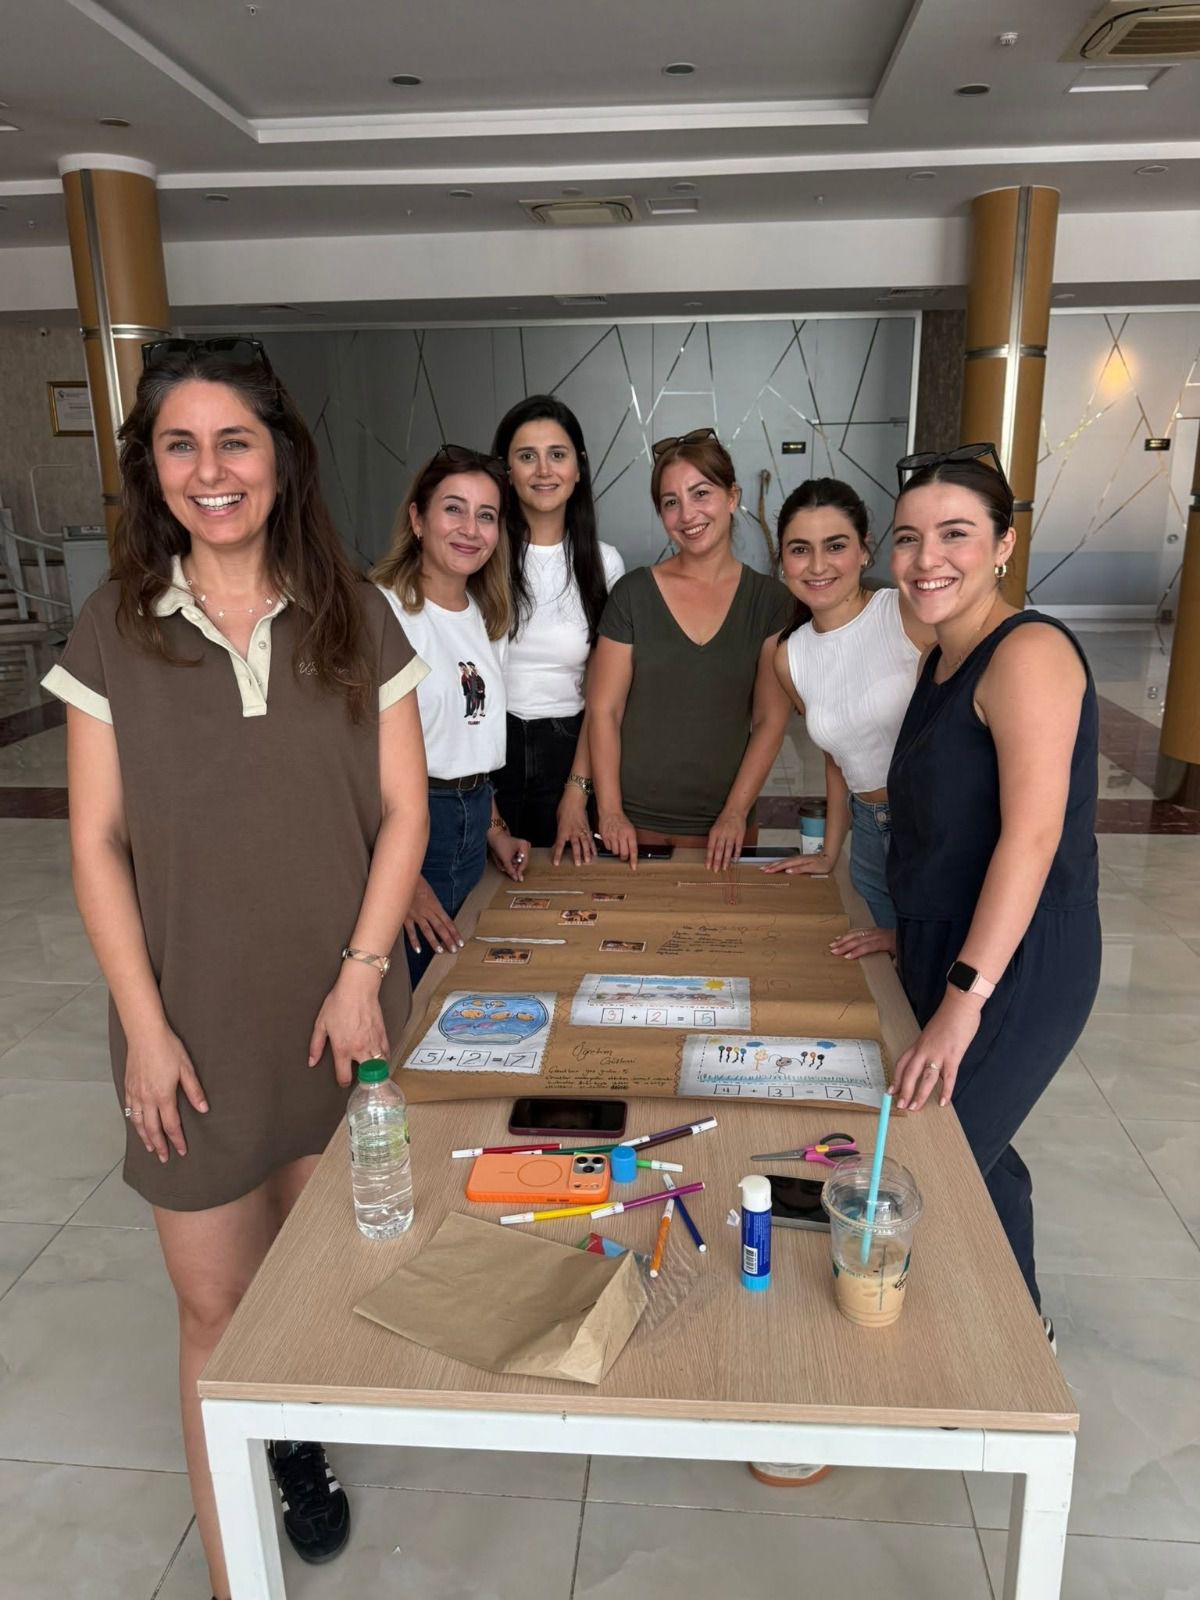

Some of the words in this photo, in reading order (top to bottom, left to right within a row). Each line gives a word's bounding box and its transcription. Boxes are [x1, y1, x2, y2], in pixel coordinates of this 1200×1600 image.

[420, 1052, 438, 1064] 5
[462, 1052, 481, 1065] 2
[510, 1055, 527, 1067] 7
